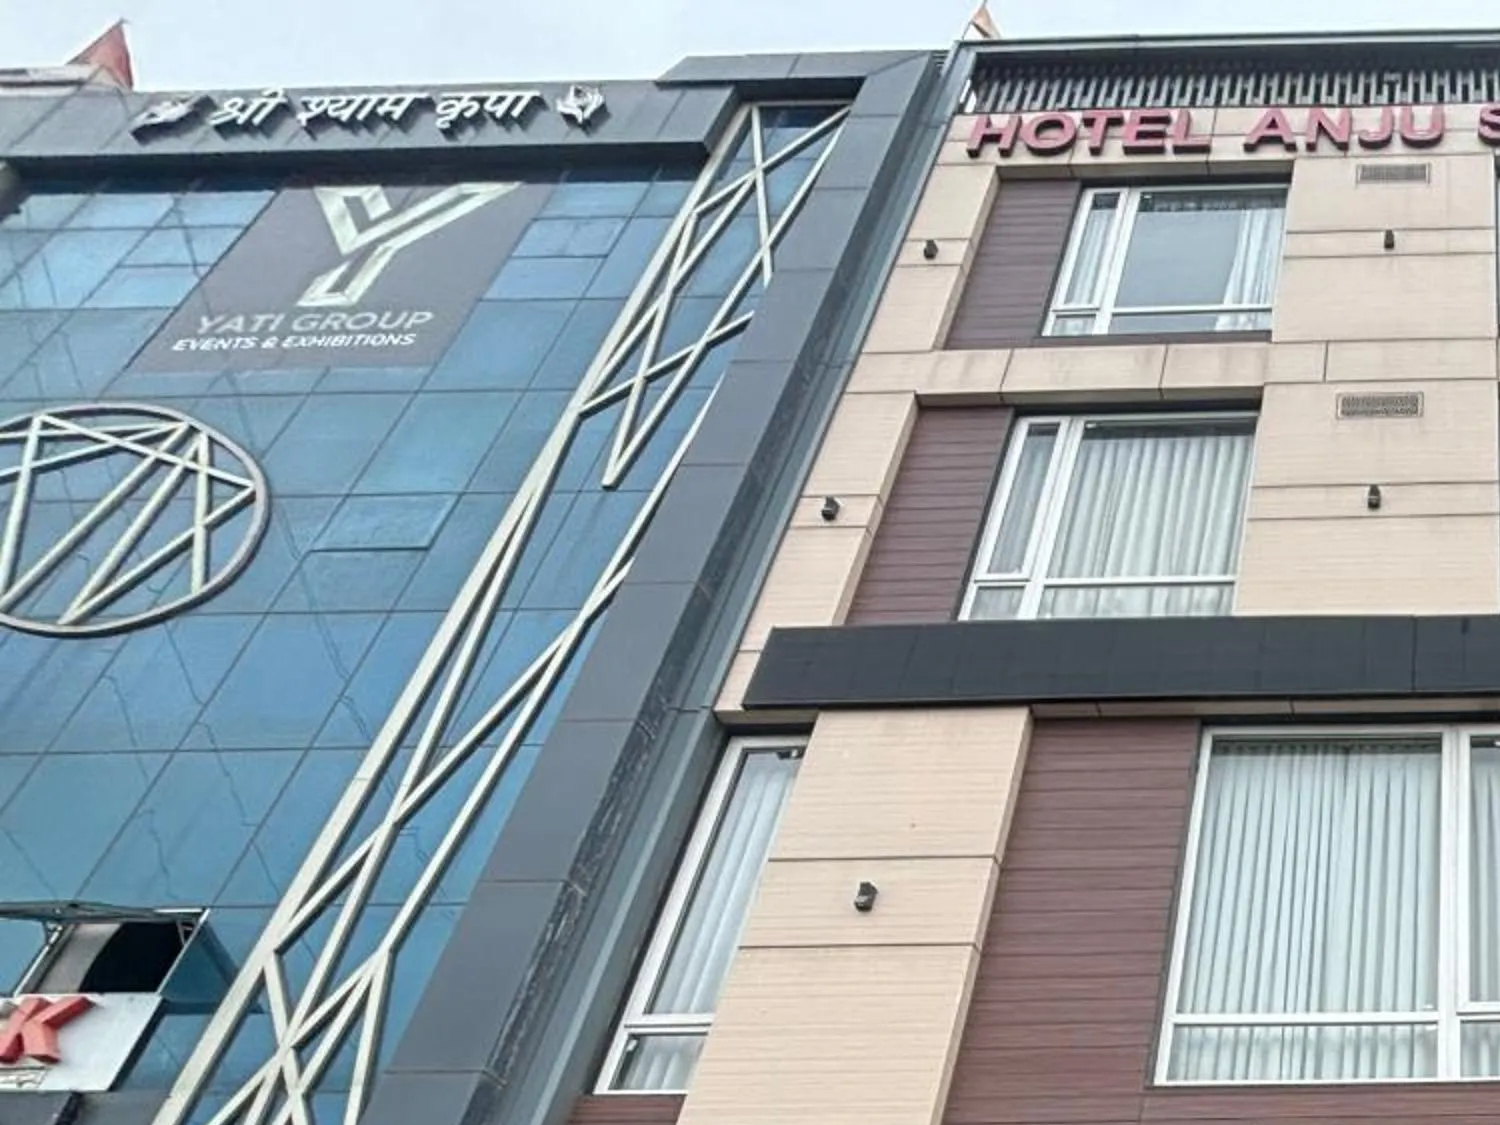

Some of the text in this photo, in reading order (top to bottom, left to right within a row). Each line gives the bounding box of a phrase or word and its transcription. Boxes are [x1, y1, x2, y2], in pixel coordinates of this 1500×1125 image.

[210, 87, 541, 129] श्री श्याम कृपा
[967, 108, 1211, 157] HOTEL
[1243, 104, 1446, 152] ANJU
[196, 311, 434, 334] YATI GROUP
[172, 333, 416, 352] EVENTS & EXHIBITIONS
